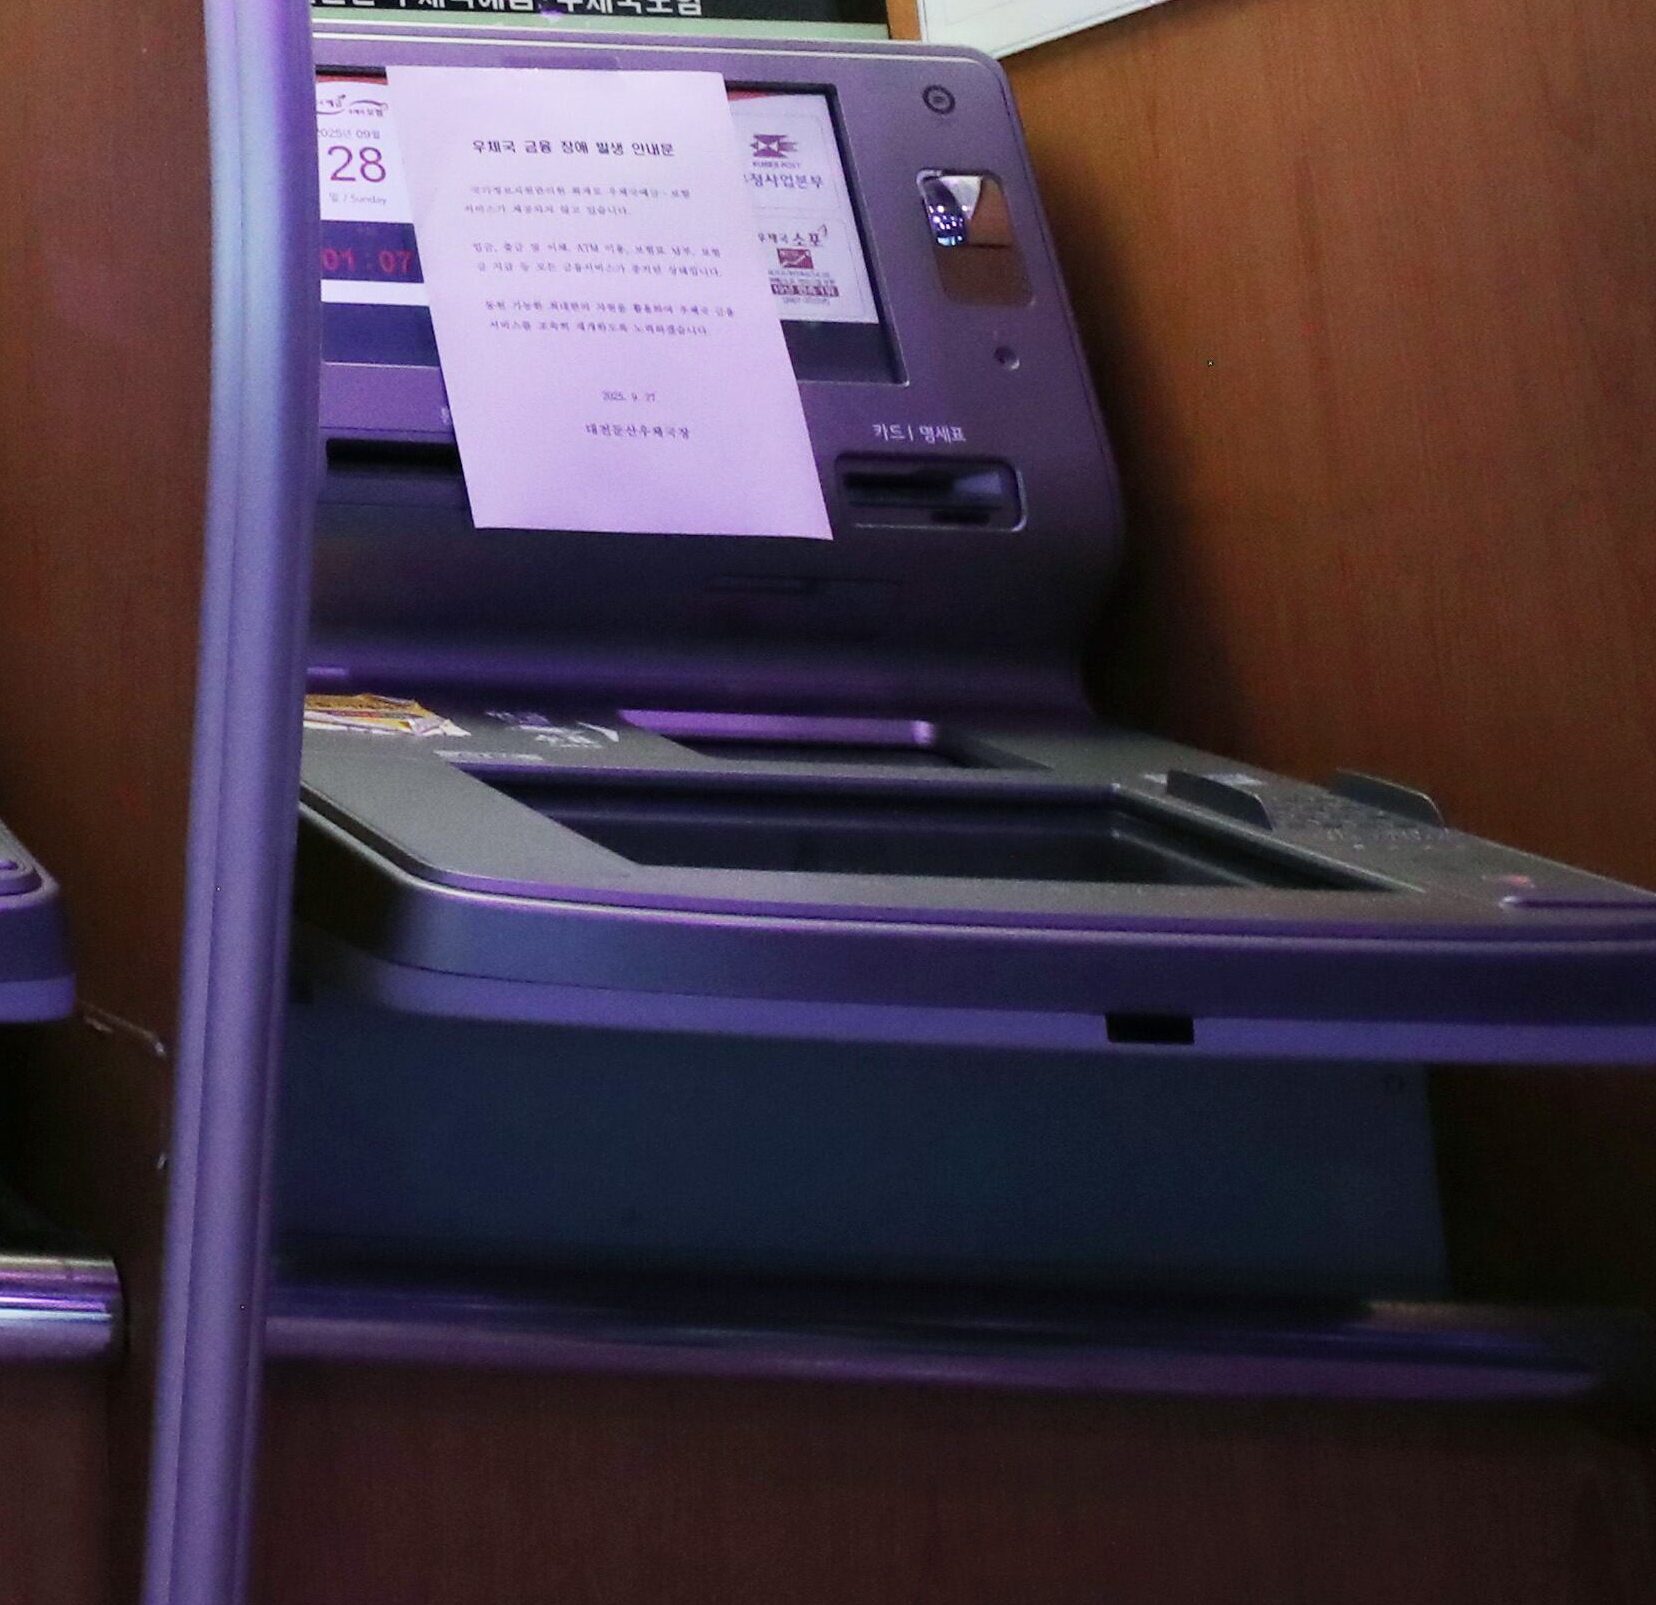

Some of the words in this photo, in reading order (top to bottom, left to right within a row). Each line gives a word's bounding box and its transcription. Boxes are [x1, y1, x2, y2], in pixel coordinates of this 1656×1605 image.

[472, 140, 516, 154] 우체국
[524, 140, 552, 154] 금융
[560, 141, 589, 155] 장애
[595, 142, 625, 156] 발생
[632, 143, 675, 157] 안내문
[328, 145, 386, 183] 28
[744, 173, 822, 189] 정사업본부
[351, 194, 386, 205] Sunday
[872, 424, 905, 441] 카드
[919, 426, 966, 444] 명세표
